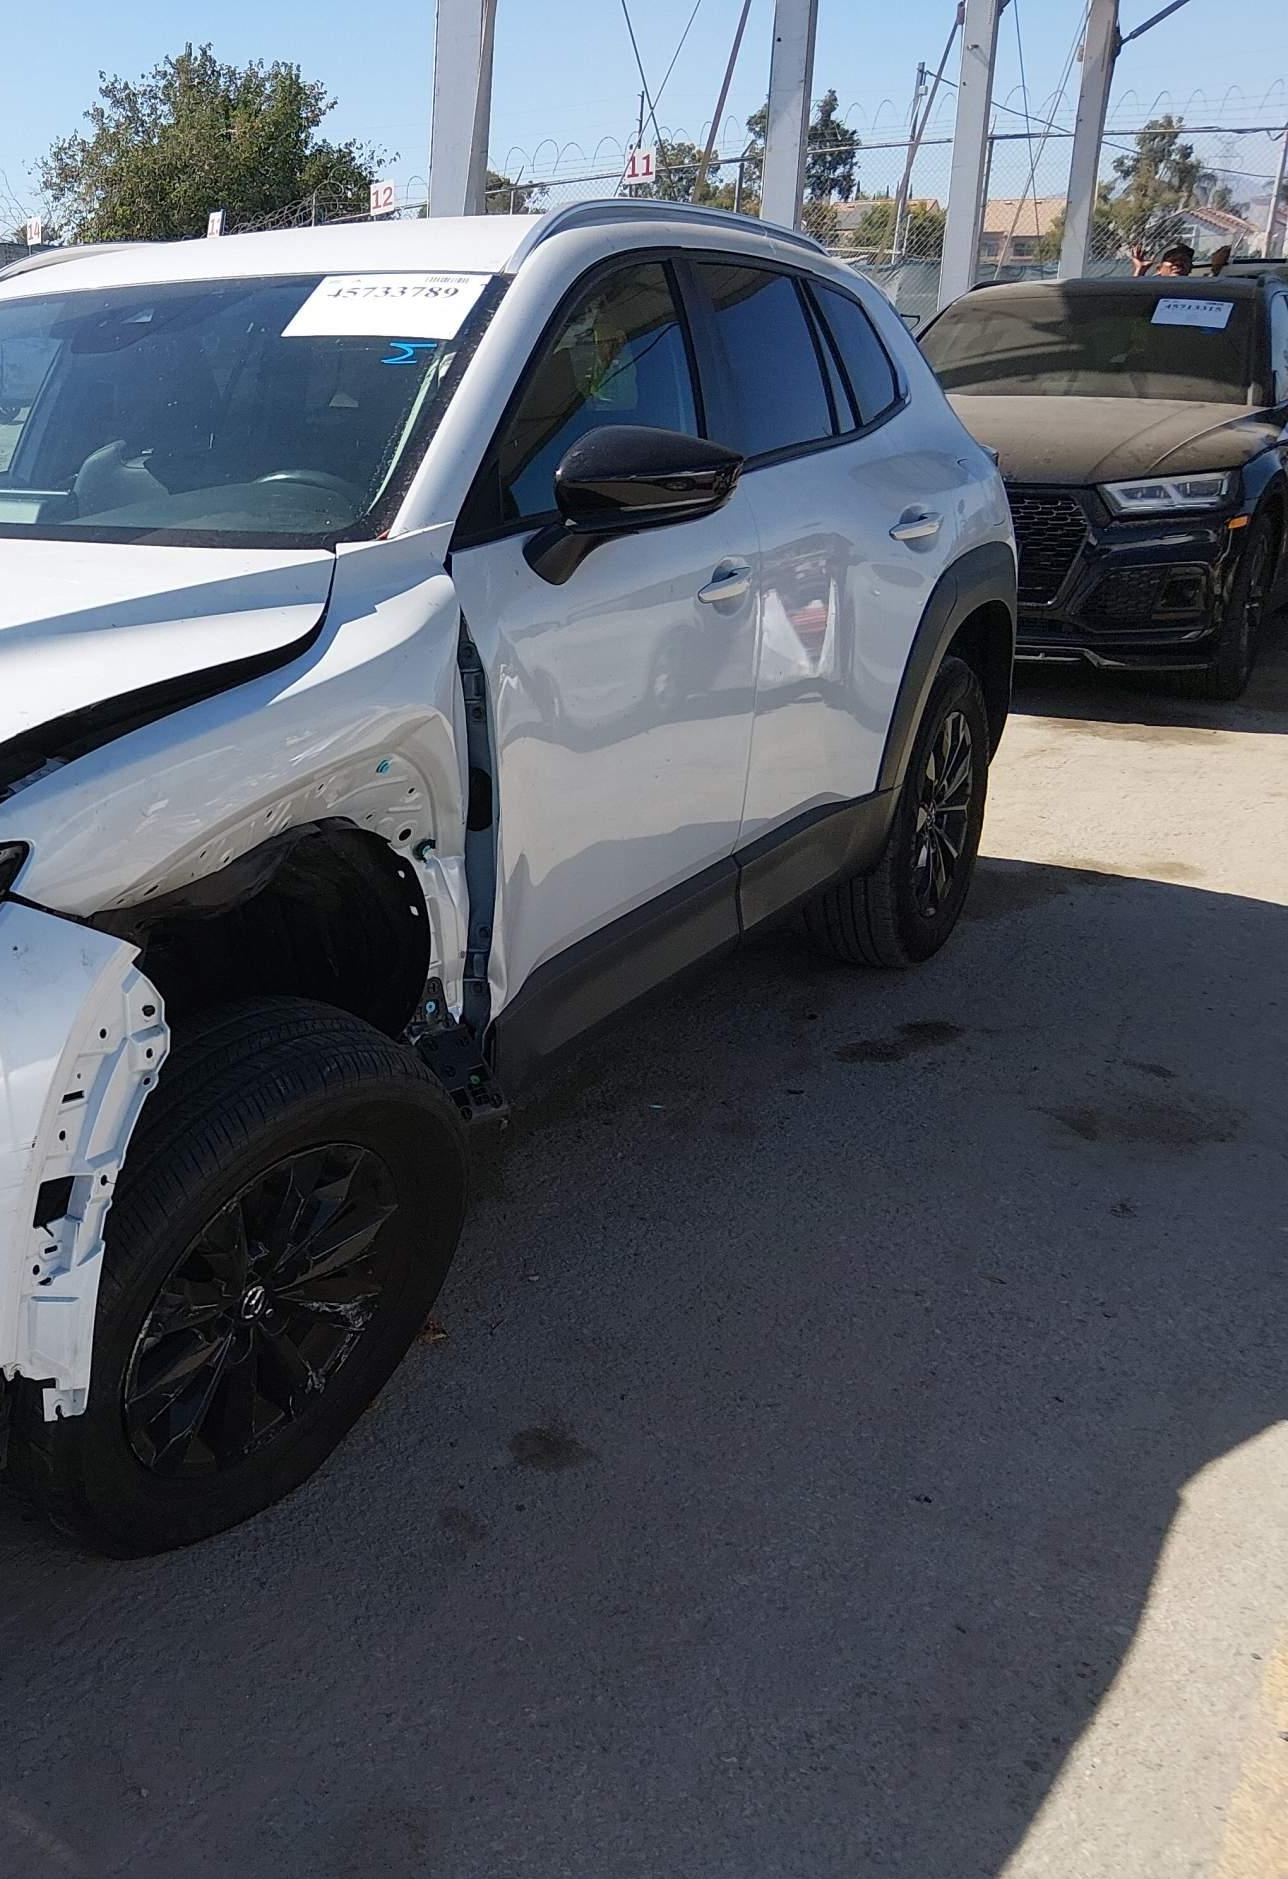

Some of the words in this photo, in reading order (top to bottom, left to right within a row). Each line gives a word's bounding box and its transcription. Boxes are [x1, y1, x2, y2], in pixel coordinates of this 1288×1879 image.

[626, 153, 654, 178] 11
[371, 186, 393, 209] 12
[28, 222, 40, 240] 14
[327, 286, 460, 298] 45733789
